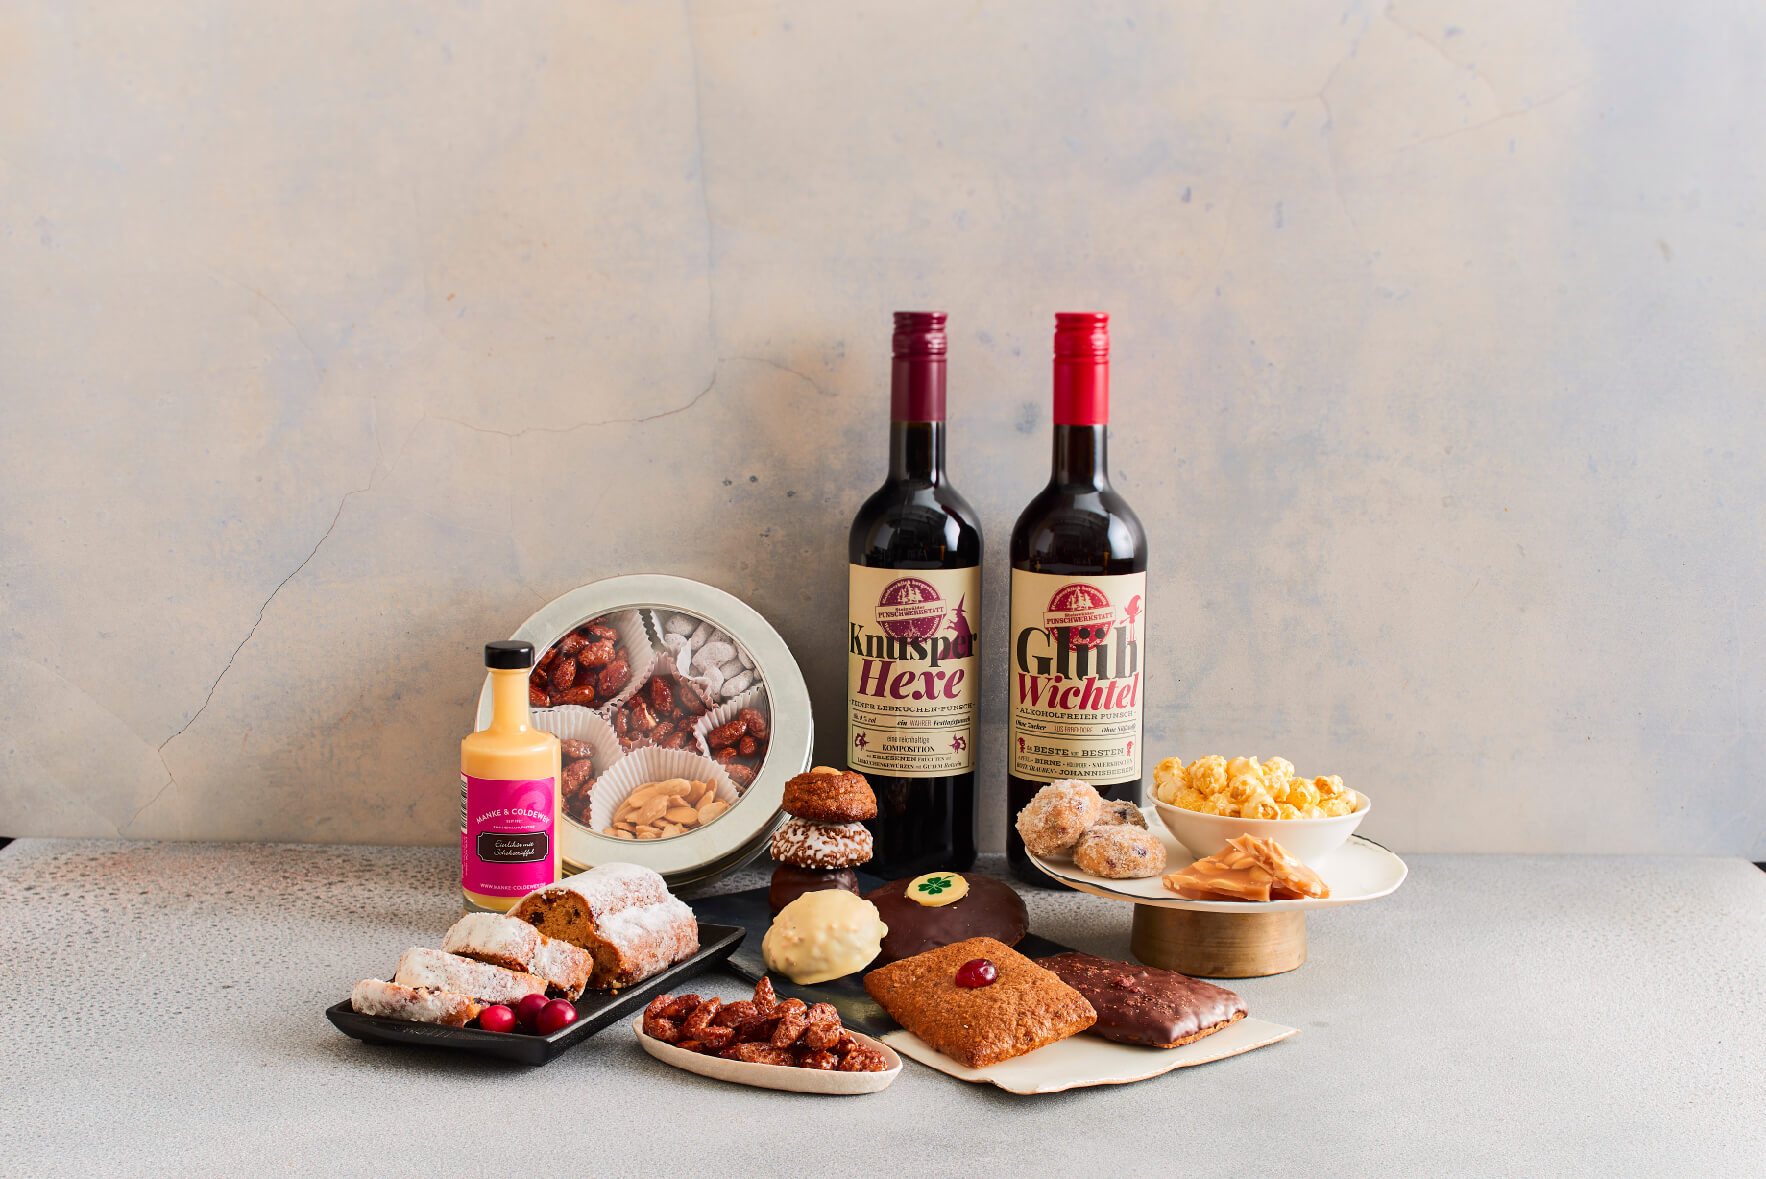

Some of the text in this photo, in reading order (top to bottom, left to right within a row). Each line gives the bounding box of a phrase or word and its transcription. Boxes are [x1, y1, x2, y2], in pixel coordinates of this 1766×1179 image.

[849, 621, 978, 668] Knusper
[1016, 626, 1138, 681] Glüh
[856, 658, 965, 701] Hexe
[1017, 671, 1140, 711] Wichtel
[1019, 707, 1133, 720] ALKOHOLFREIER PUNSCH
[1033, 745, 1069, 756] BESTE
[1081, 747, 1124, 757] BESTEN
[1034, 757, 1061, 767] BIRNE
[476, 809, 502, 824] MANKE
[503, 808, 510, 816] &
